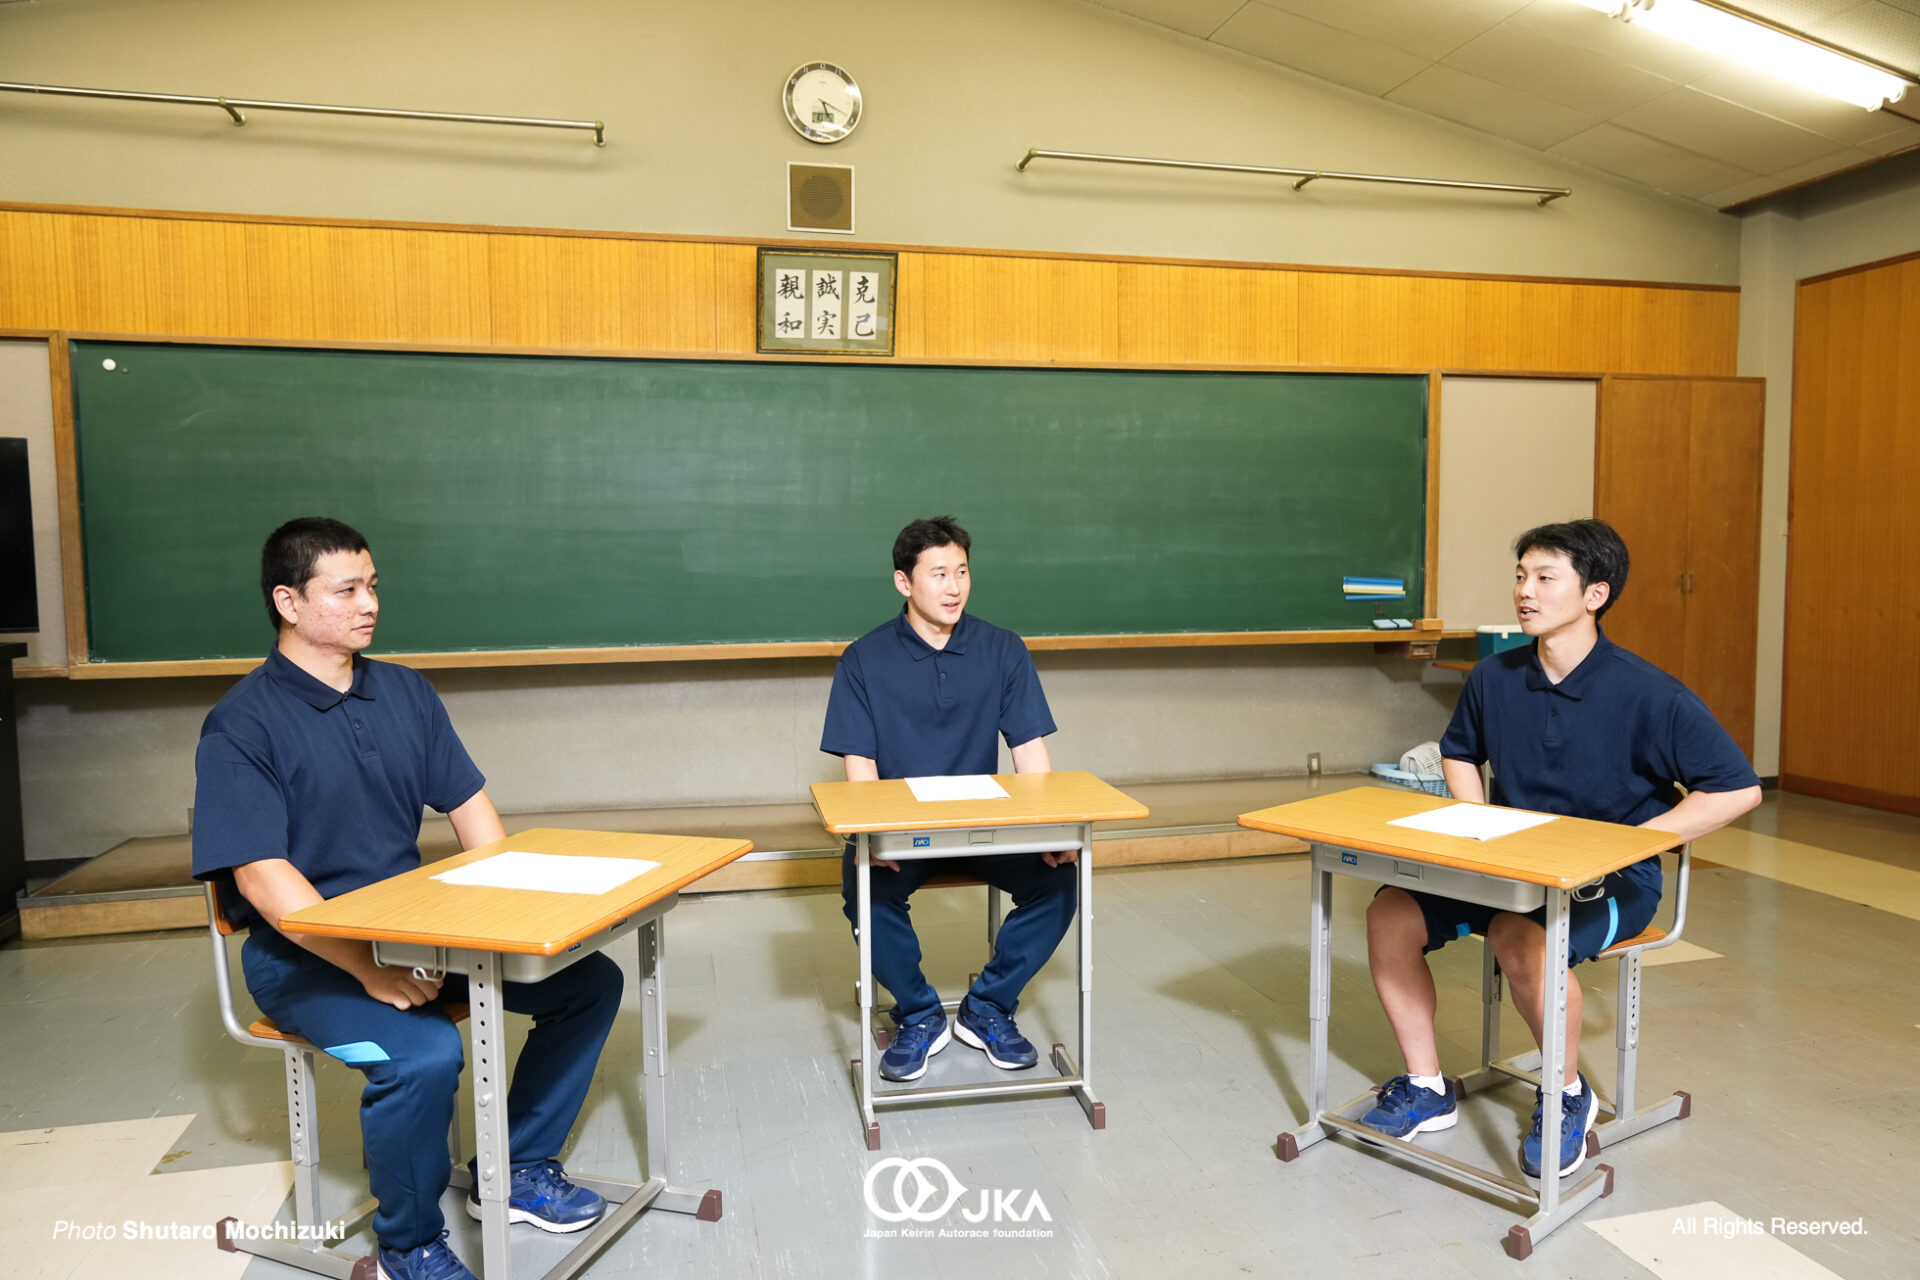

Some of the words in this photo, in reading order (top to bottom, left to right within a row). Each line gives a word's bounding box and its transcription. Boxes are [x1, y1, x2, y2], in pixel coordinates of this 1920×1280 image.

[777, 274, 804, 334] 親和
[816, 273, 840, 335] 誠実
[855, 275, 876, 337] 克己
